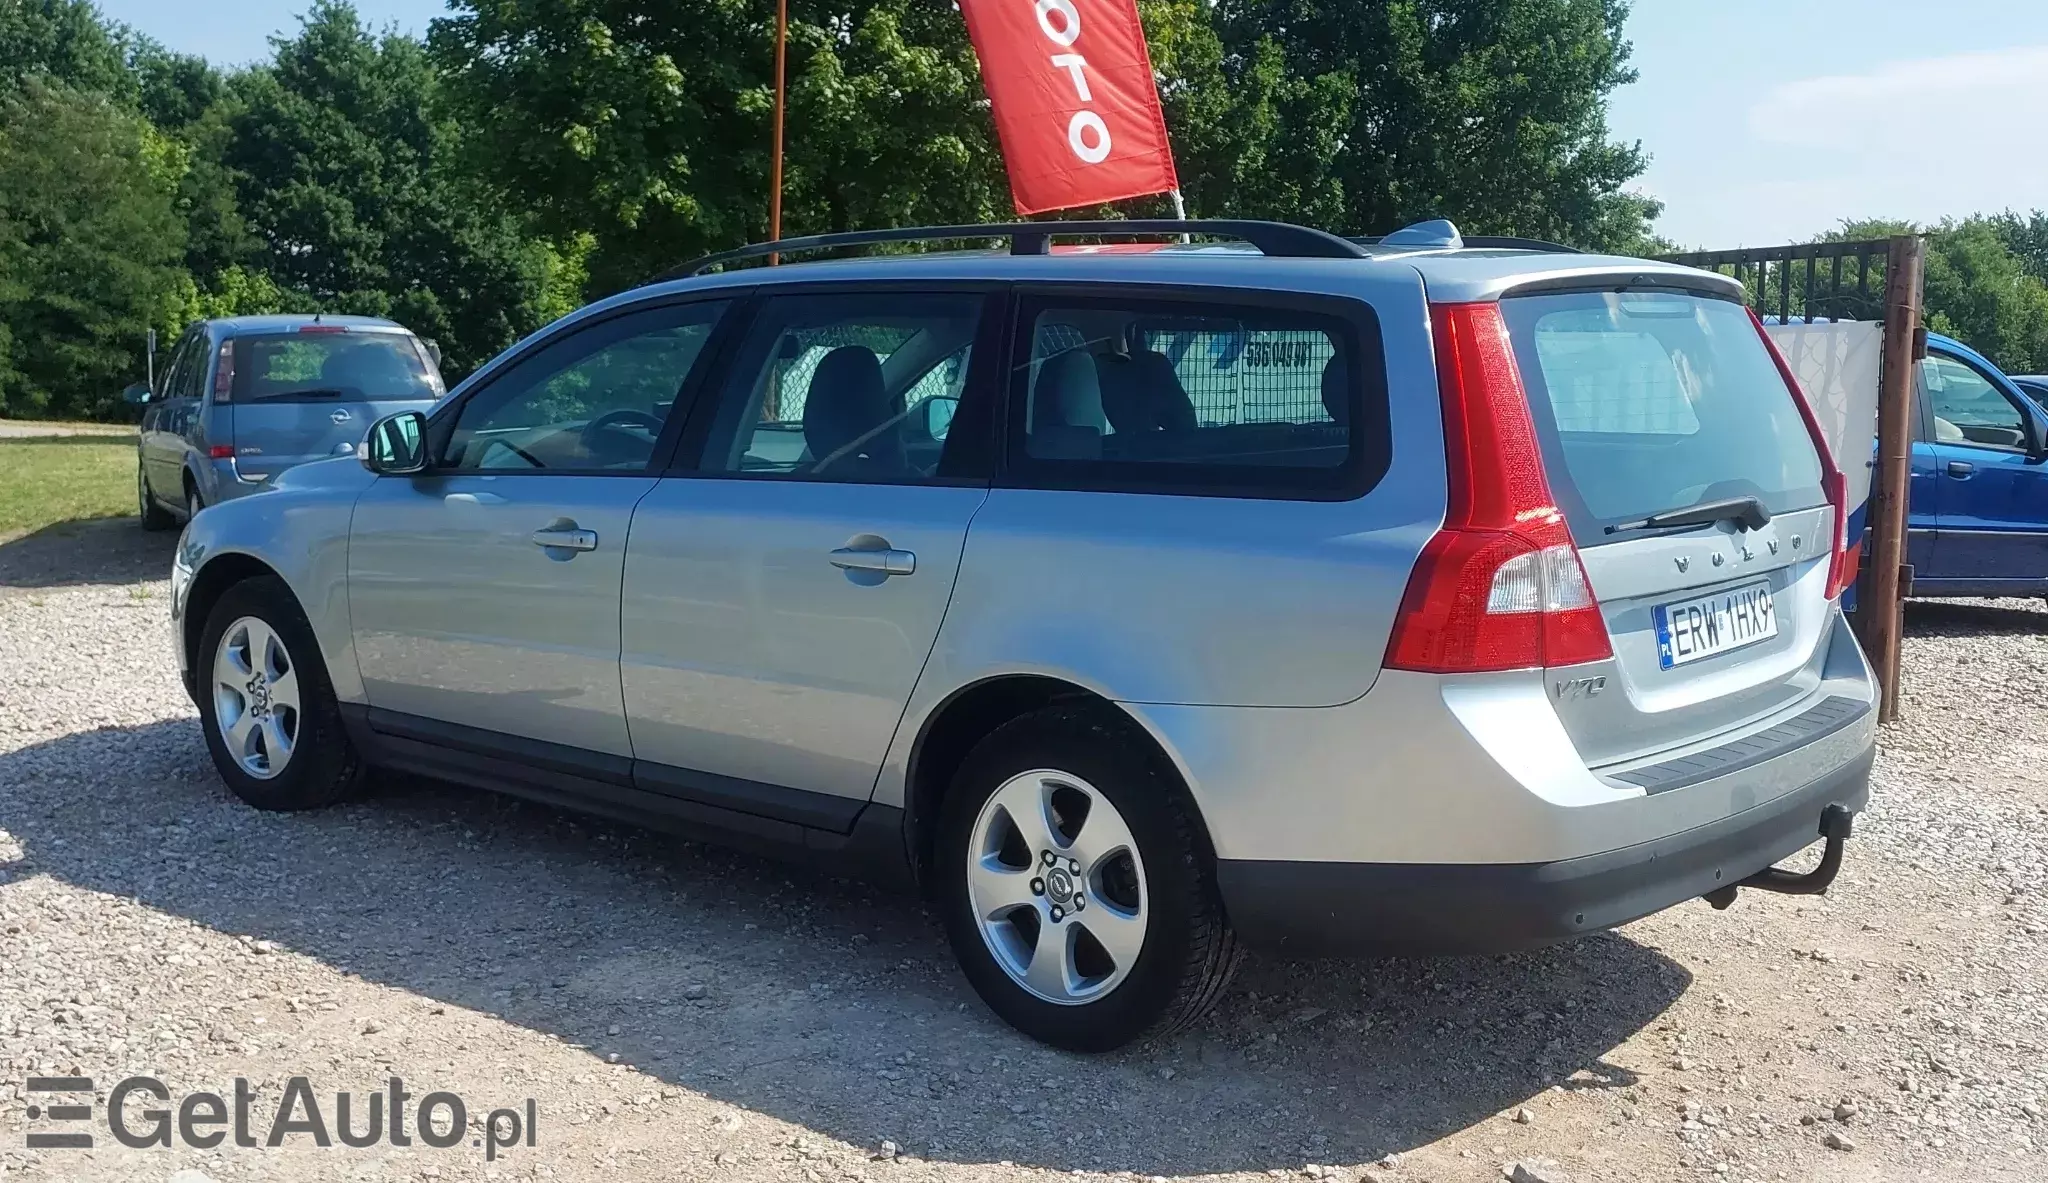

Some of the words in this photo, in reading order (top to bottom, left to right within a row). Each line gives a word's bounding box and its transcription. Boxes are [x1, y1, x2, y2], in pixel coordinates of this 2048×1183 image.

[1674, 534, 1802, 574] VOLVO
[1672, 600, 1720, 657] ERW
[1725, 588, 1769, 642] 1HX9
[1661, 643, 1672, 657] PL
[1555, 675, 1607, 700] V70
